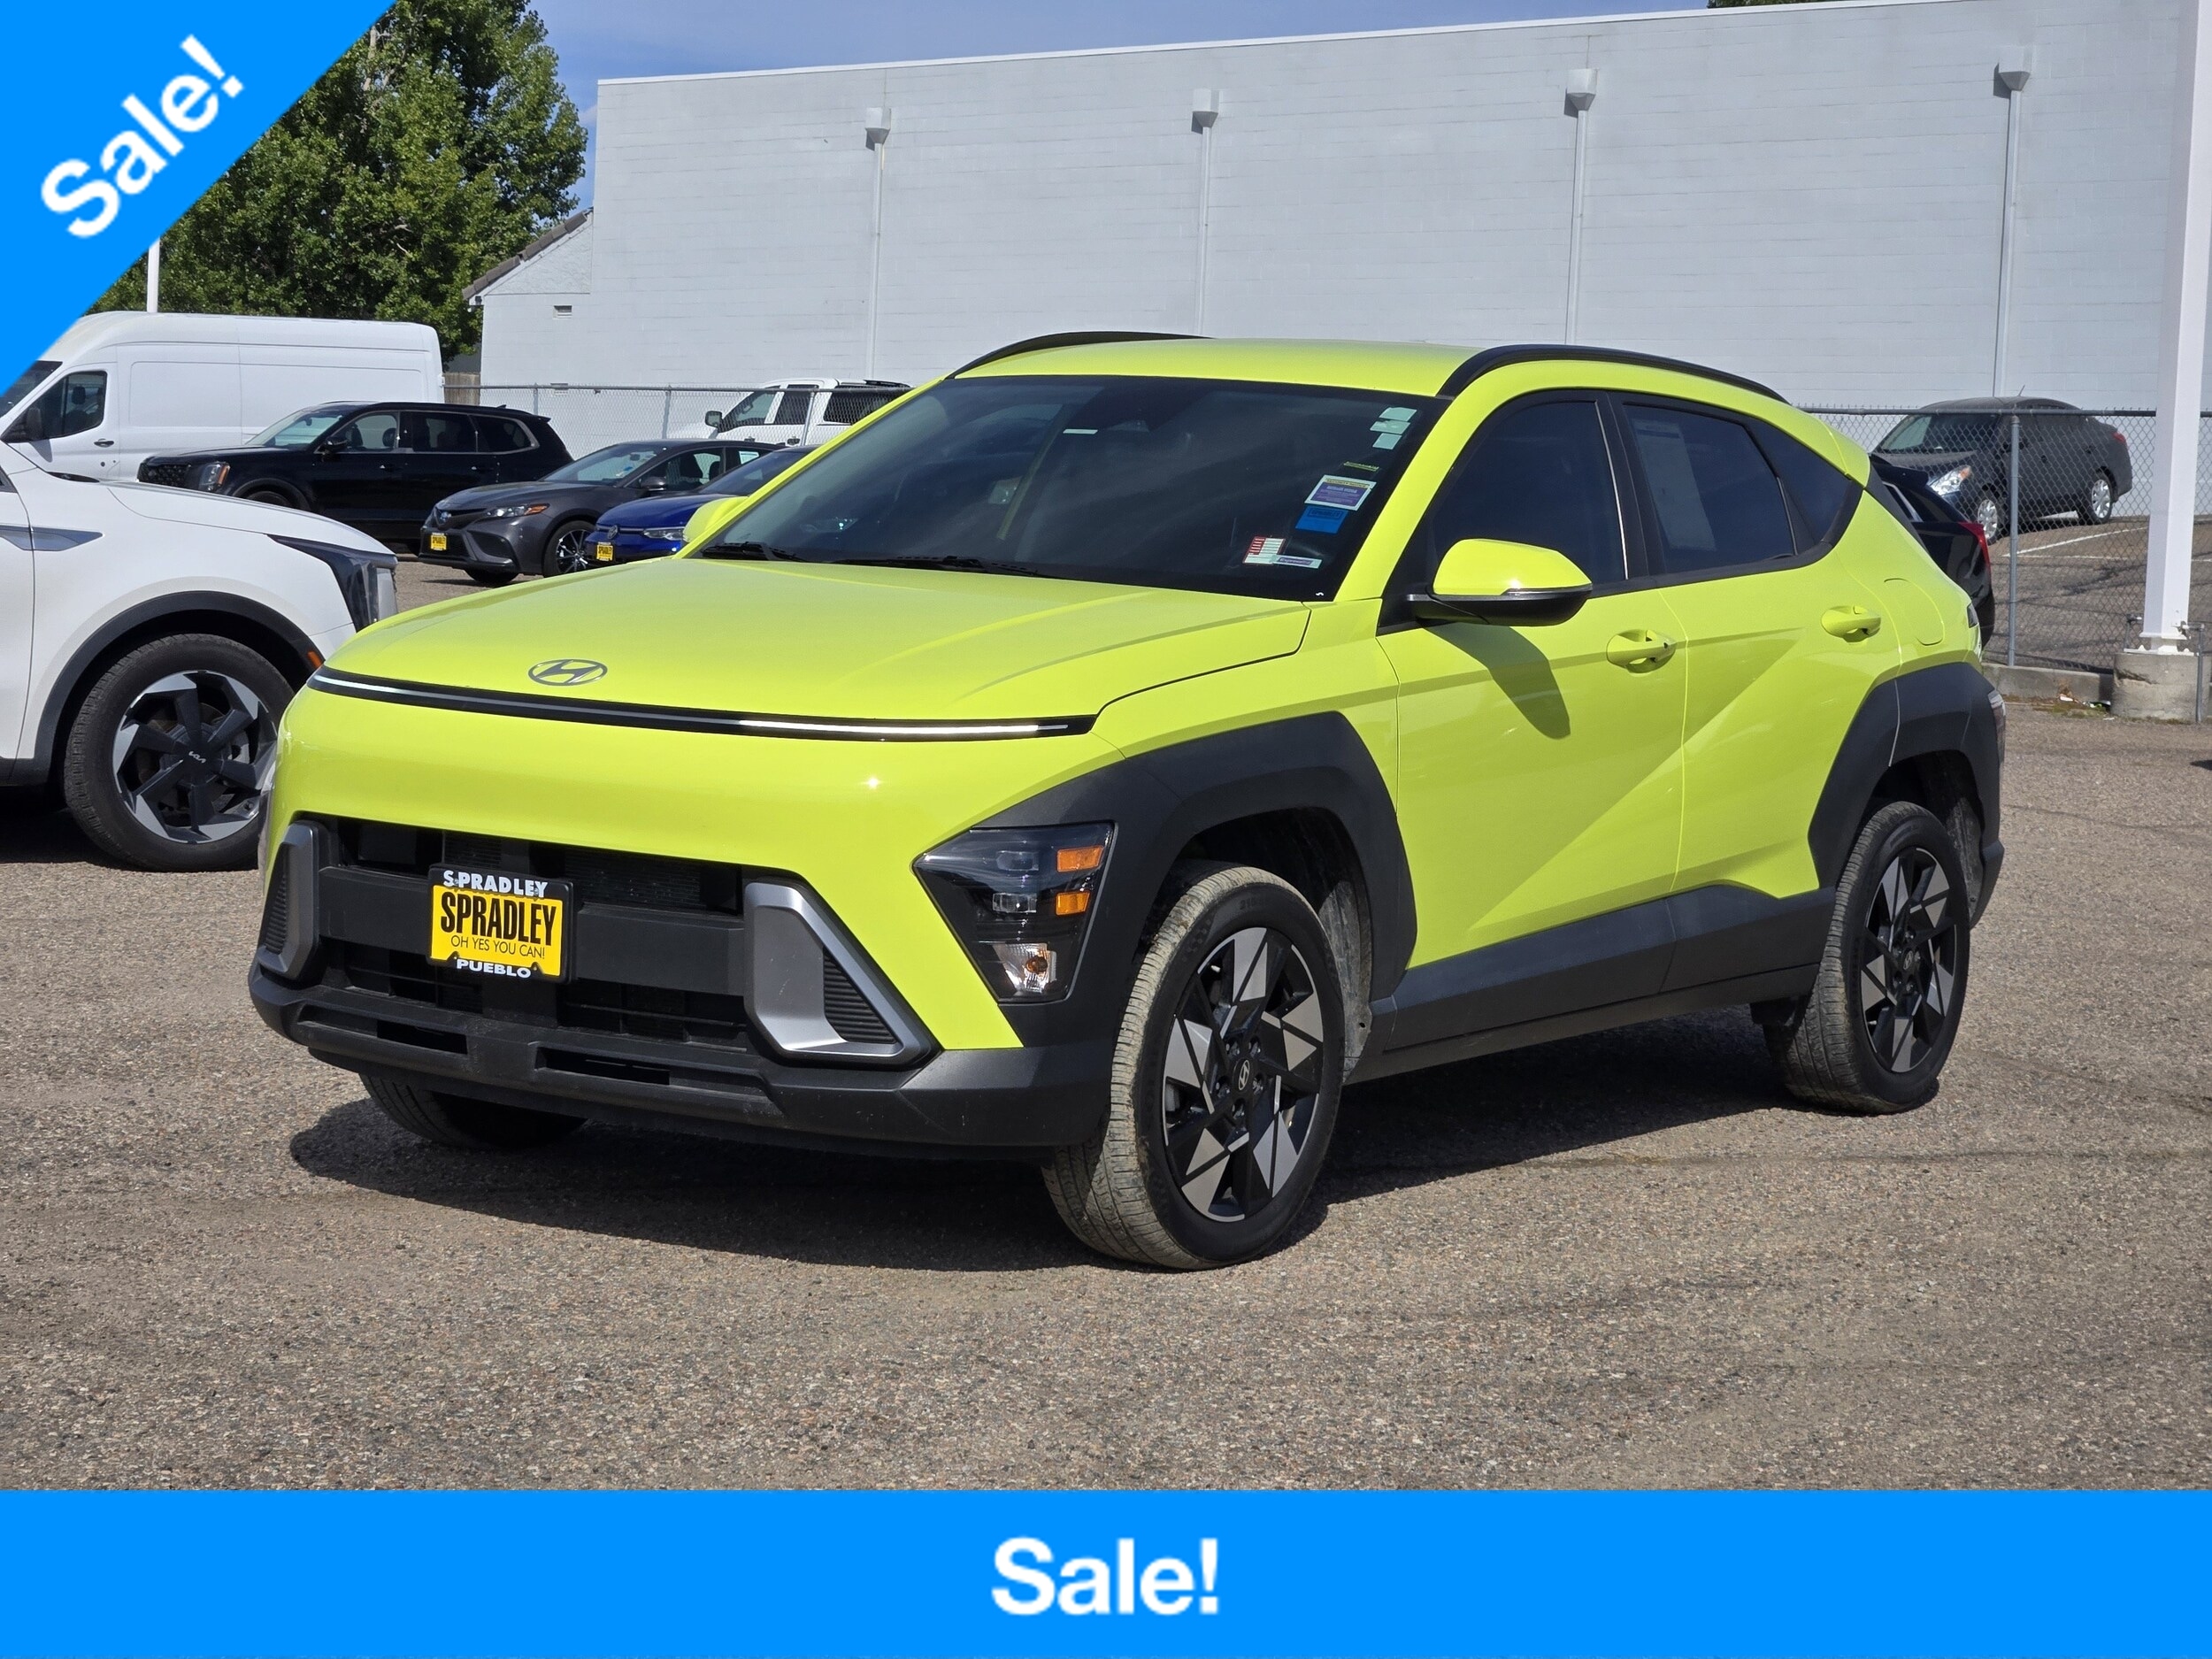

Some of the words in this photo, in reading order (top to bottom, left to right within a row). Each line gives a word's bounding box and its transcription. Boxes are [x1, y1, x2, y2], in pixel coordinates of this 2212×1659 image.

[443, 870, 548, 898] SPRADLEY
[441, 892, 557, 946] SPRADLEY
[451, 934, 469, 949] OH
[472, 937, 490, 951] YES
[493, 941, 516, 955] YOU
[519, 944, 545, 960] CAN!
[457, 958, 532, 979] PUEBLO
